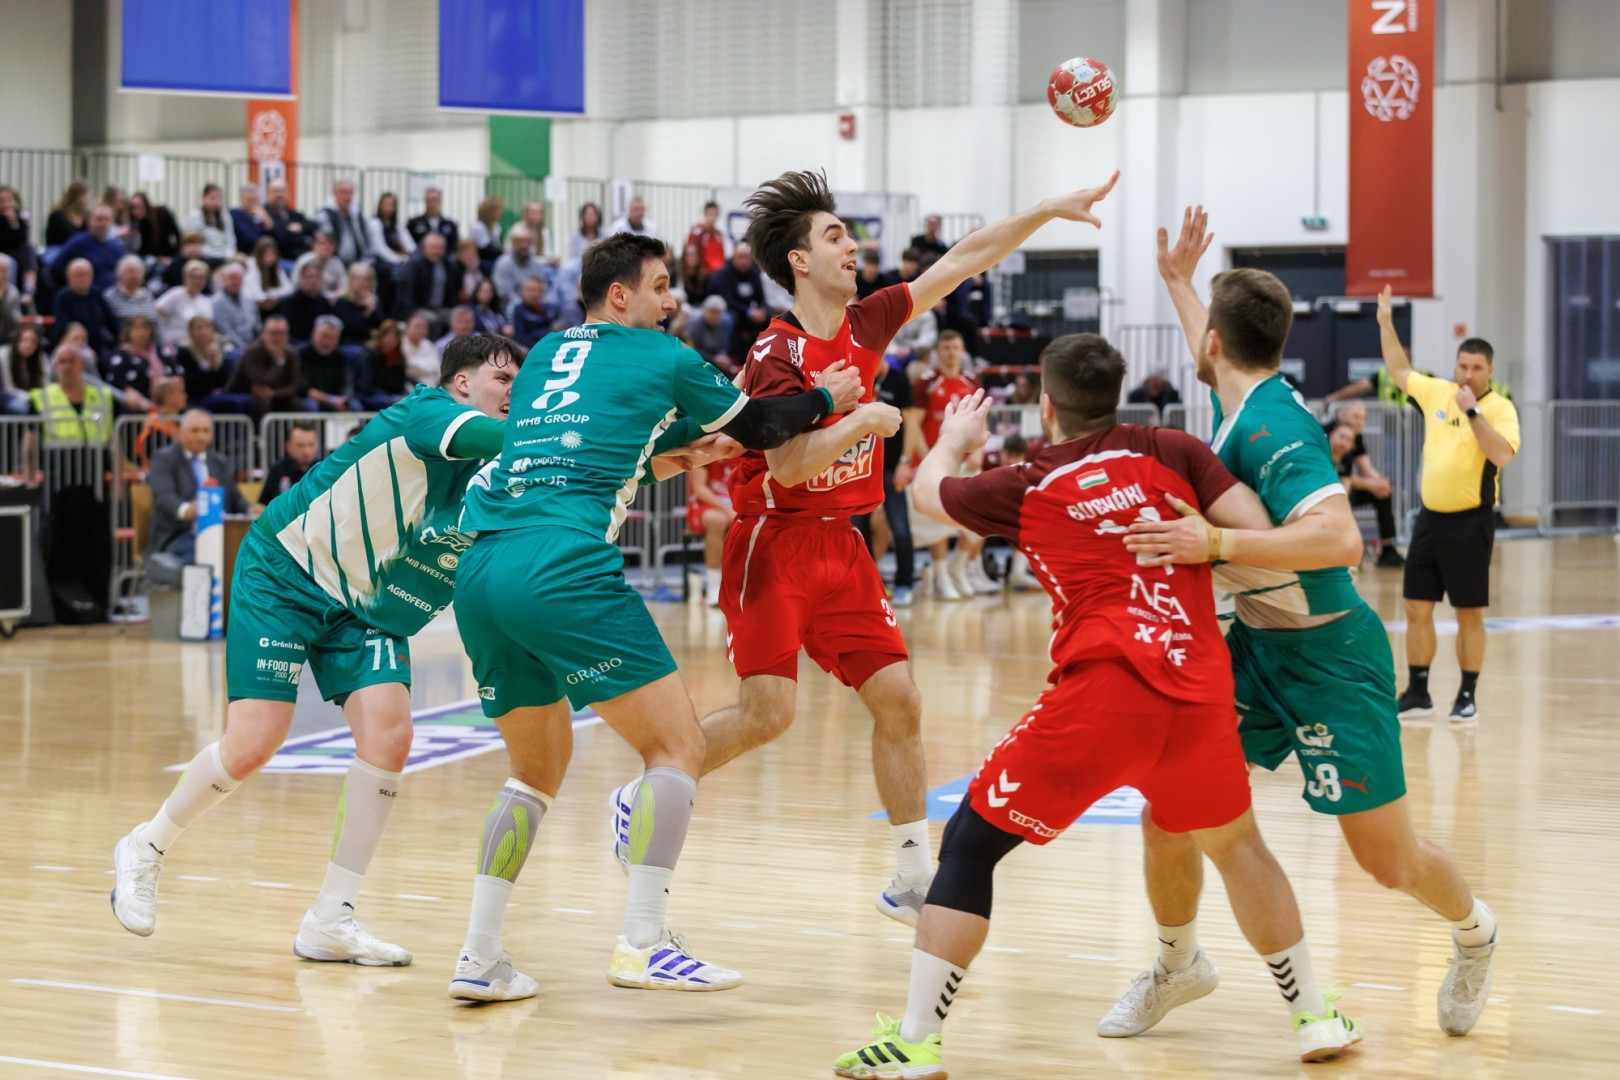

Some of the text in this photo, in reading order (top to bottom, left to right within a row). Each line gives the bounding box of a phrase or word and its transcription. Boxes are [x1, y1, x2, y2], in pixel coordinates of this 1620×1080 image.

[1074, 76, 1112, 104] SELECT
[543, 340, 593, 391] 9
[516, 413, 590, 428] WHB GROUP
[405, 556, 420, 568] MIB
[420, 563, 444, 580] INVEST
[386, 583, 432, 612] AGROFEED
[271, 640, 293, 649] Gránit
[365, 637, 398, 671] 71
[256, 658, 289, 672] IN-FOOD
[274, 671, 288, 679] 2000
[566, 657, 623, 685] GRABO
[379, 788, 398, 798] SELE
